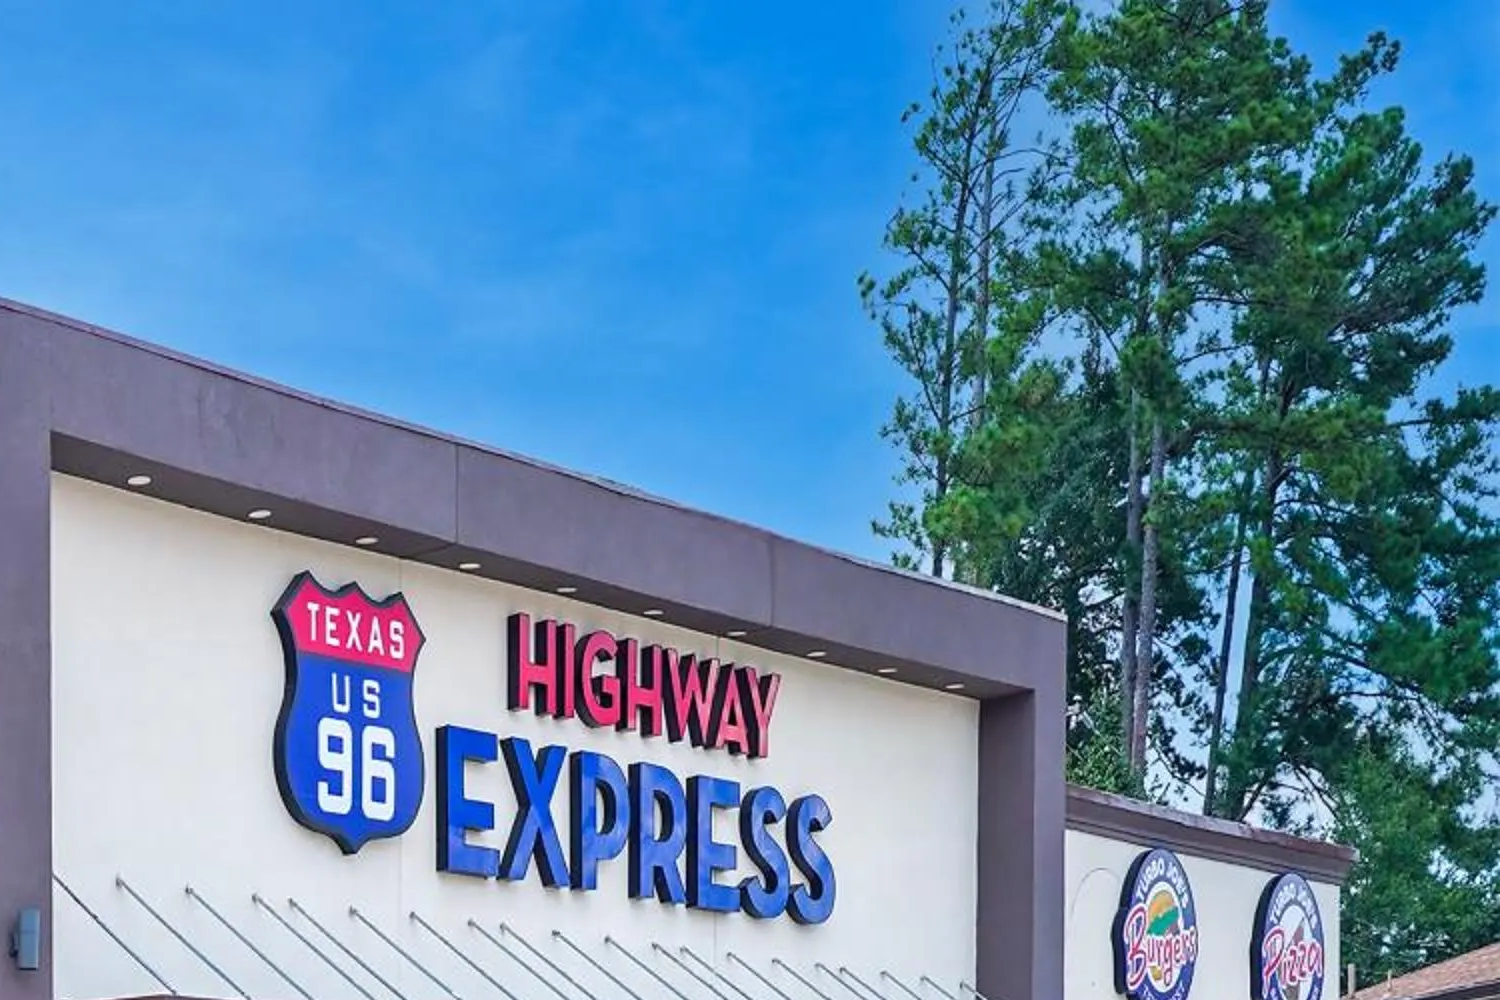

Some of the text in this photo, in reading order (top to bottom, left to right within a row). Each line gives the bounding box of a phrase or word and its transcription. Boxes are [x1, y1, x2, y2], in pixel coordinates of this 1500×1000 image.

[307, 601, 404, 660] TEXAS
[331, 672, 381, 719] US
[508, 612, 781, 759] HIGHWAY
[317, 716, 396, 822] 96
[436, 725, 837, 924] EXPRESS
[1262, 926, 1323, 1000] Pizza
